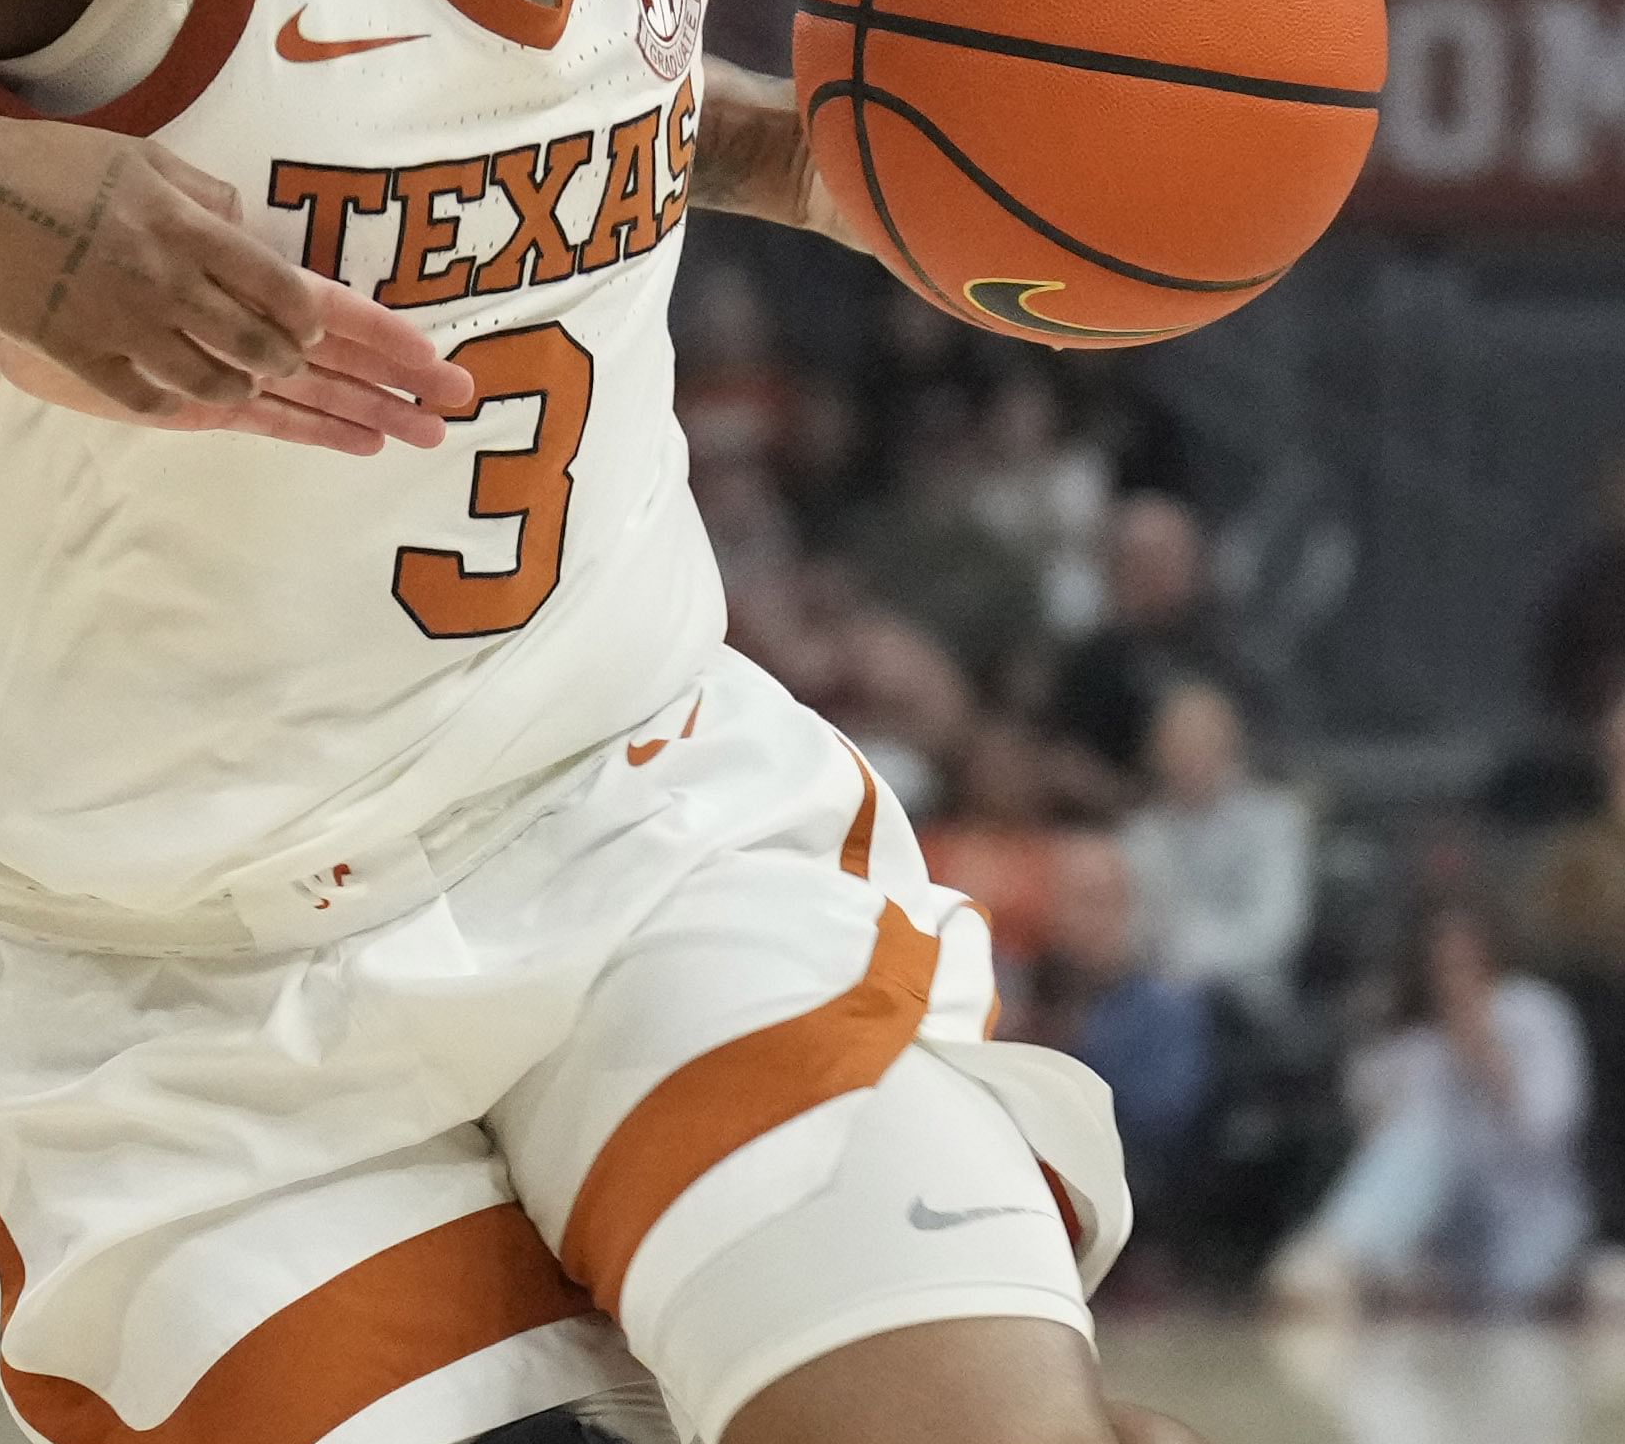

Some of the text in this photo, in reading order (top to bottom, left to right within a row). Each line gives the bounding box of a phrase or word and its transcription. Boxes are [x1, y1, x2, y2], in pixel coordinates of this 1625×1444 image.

[648, 12, 698, 79] GRADUATE
[268, 74, 698, 310] TEXAS
[392, 320, 594, 639] 3
